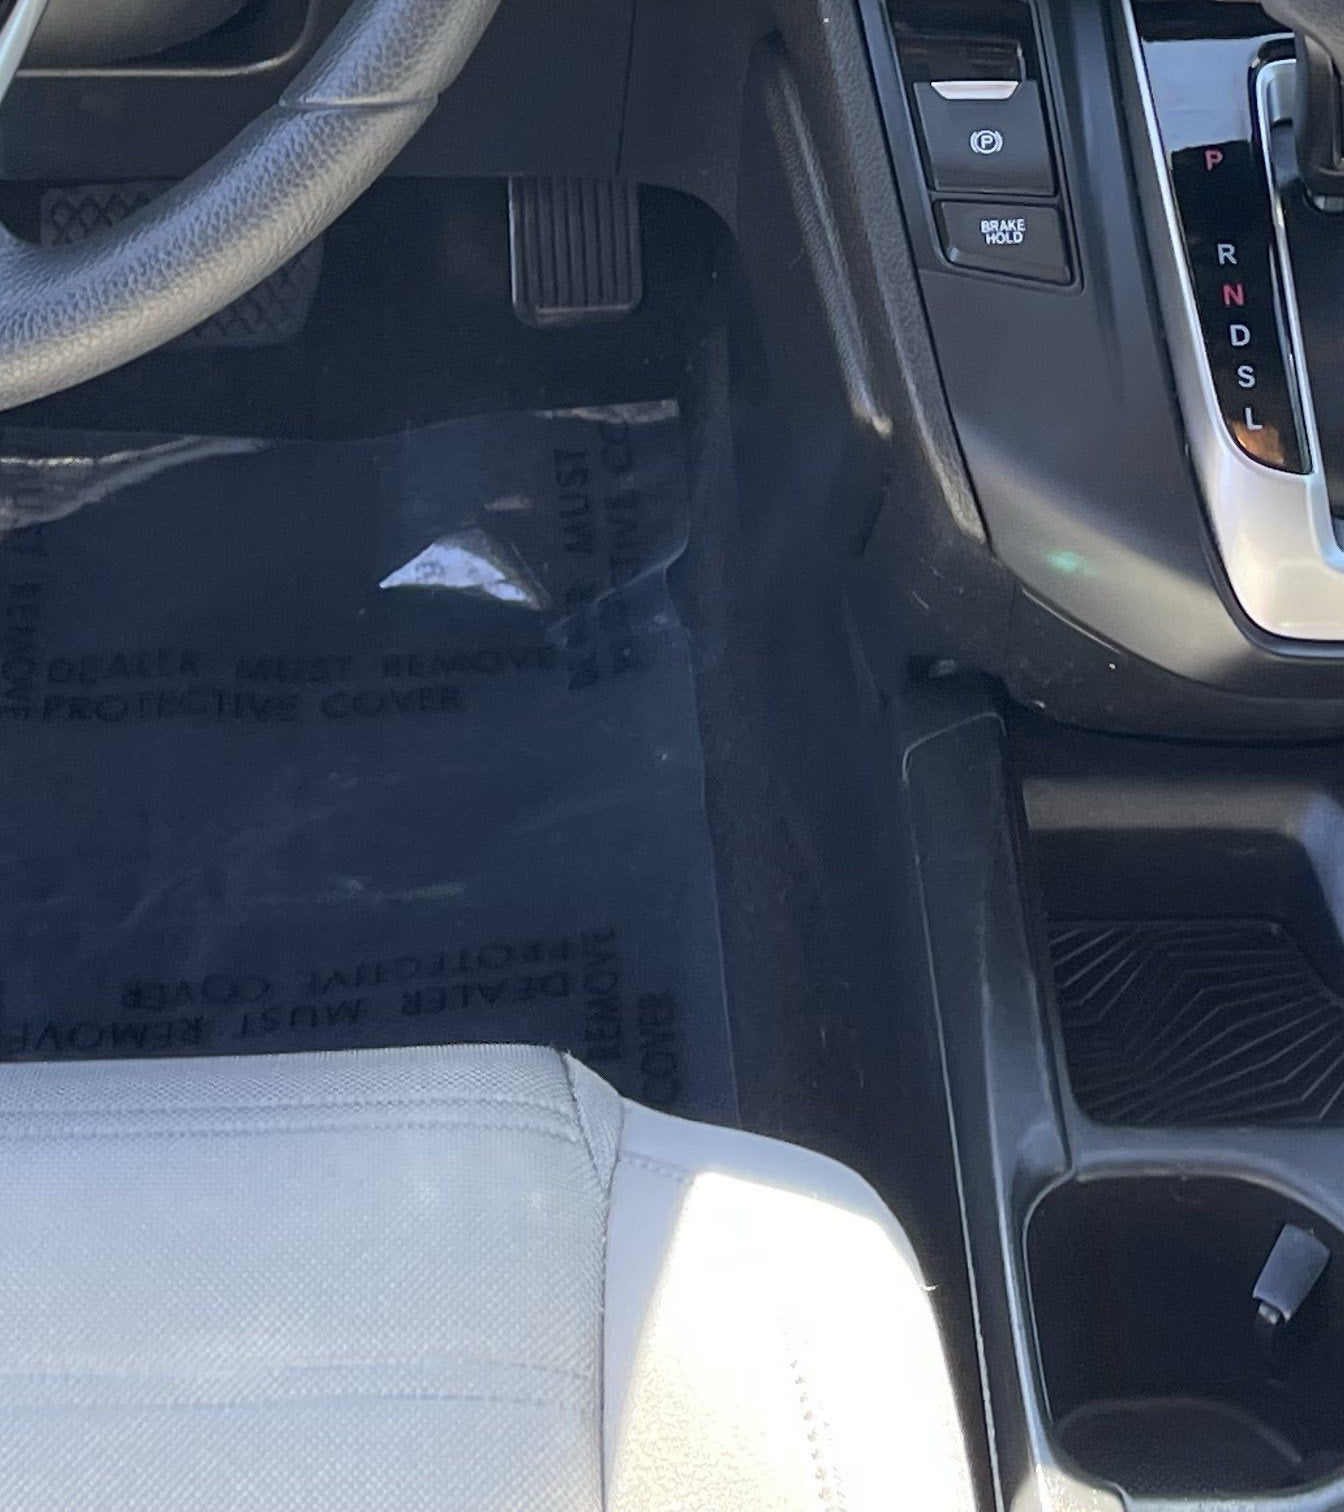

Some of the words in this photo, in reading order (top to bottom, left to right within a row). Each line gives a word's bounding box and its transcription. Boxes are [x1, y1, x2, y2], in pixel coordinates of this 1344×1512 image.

[1205, 149, 1224, 170] P
[980, 219, 1026, 235] BRAKE
[985, 232, 1024, 245] HOLD
[1217, 243, 1238, 266] R
[1222, 284, 1245, 307] N
[1230, 324, 1251, 347] D
[1237, 364, 1256, 389] S
[1244, 407, 1263, 431] L
[46, 648, 202, 688] DEALER
[232, 651, 354, 684] MUST
[382, 642, 558, 680] REMOVE
[40, 688, 302, 725] PROTECTIVE
[319, 685, 464, 721] COVER
[234, 996, 364, 1041] MUST
